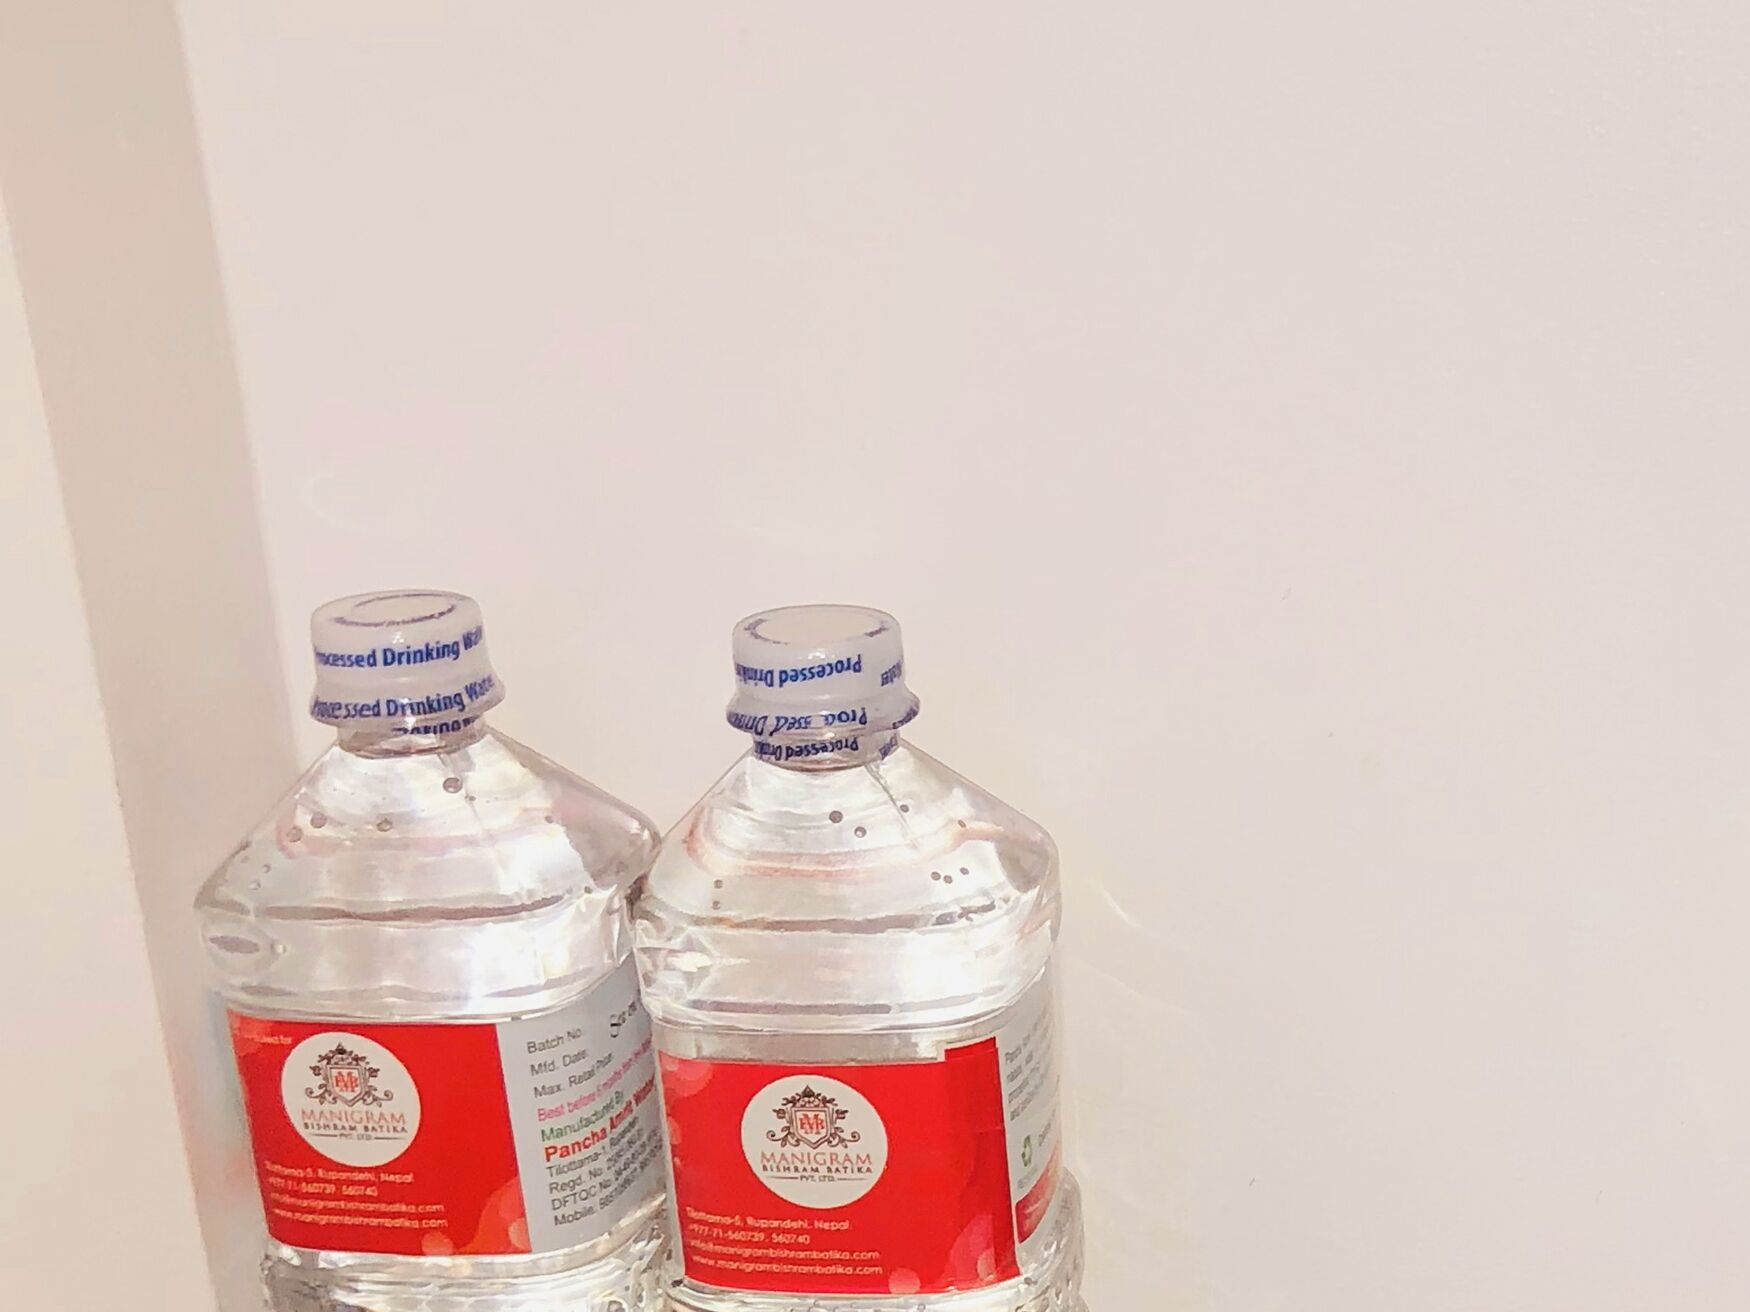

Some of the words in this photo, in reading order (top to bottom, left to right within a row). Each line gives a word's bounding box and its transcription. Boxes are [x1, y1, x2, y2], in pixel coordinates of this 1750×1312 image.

[382, 640, 461, 667] Drinking
[778, 654, 863, 688] Processed
[386, 691, 467, 718] Drinking
[784, 736, 859, 761] Processed
[527, 1035, 565, 1054] Batch
[534, 1084, 566, 1098] Max.
[301, 1109, 406, 1125] MANIGRAM
[537, 1104, 565, 1121] Best
[303, 1122, 357, 1132] BISHRAM
[363, 1125, 408, 1134] BATIKA
[544, 1127, 608, 1162] Pancha
[760, 1151, 873, 1166] MANIGRAM
[762, 1165, 819, 1174] BISHRAM
[827, 1166, 873, 1174] BATIKA
[814, 1220, 850, 1231] Nepal
